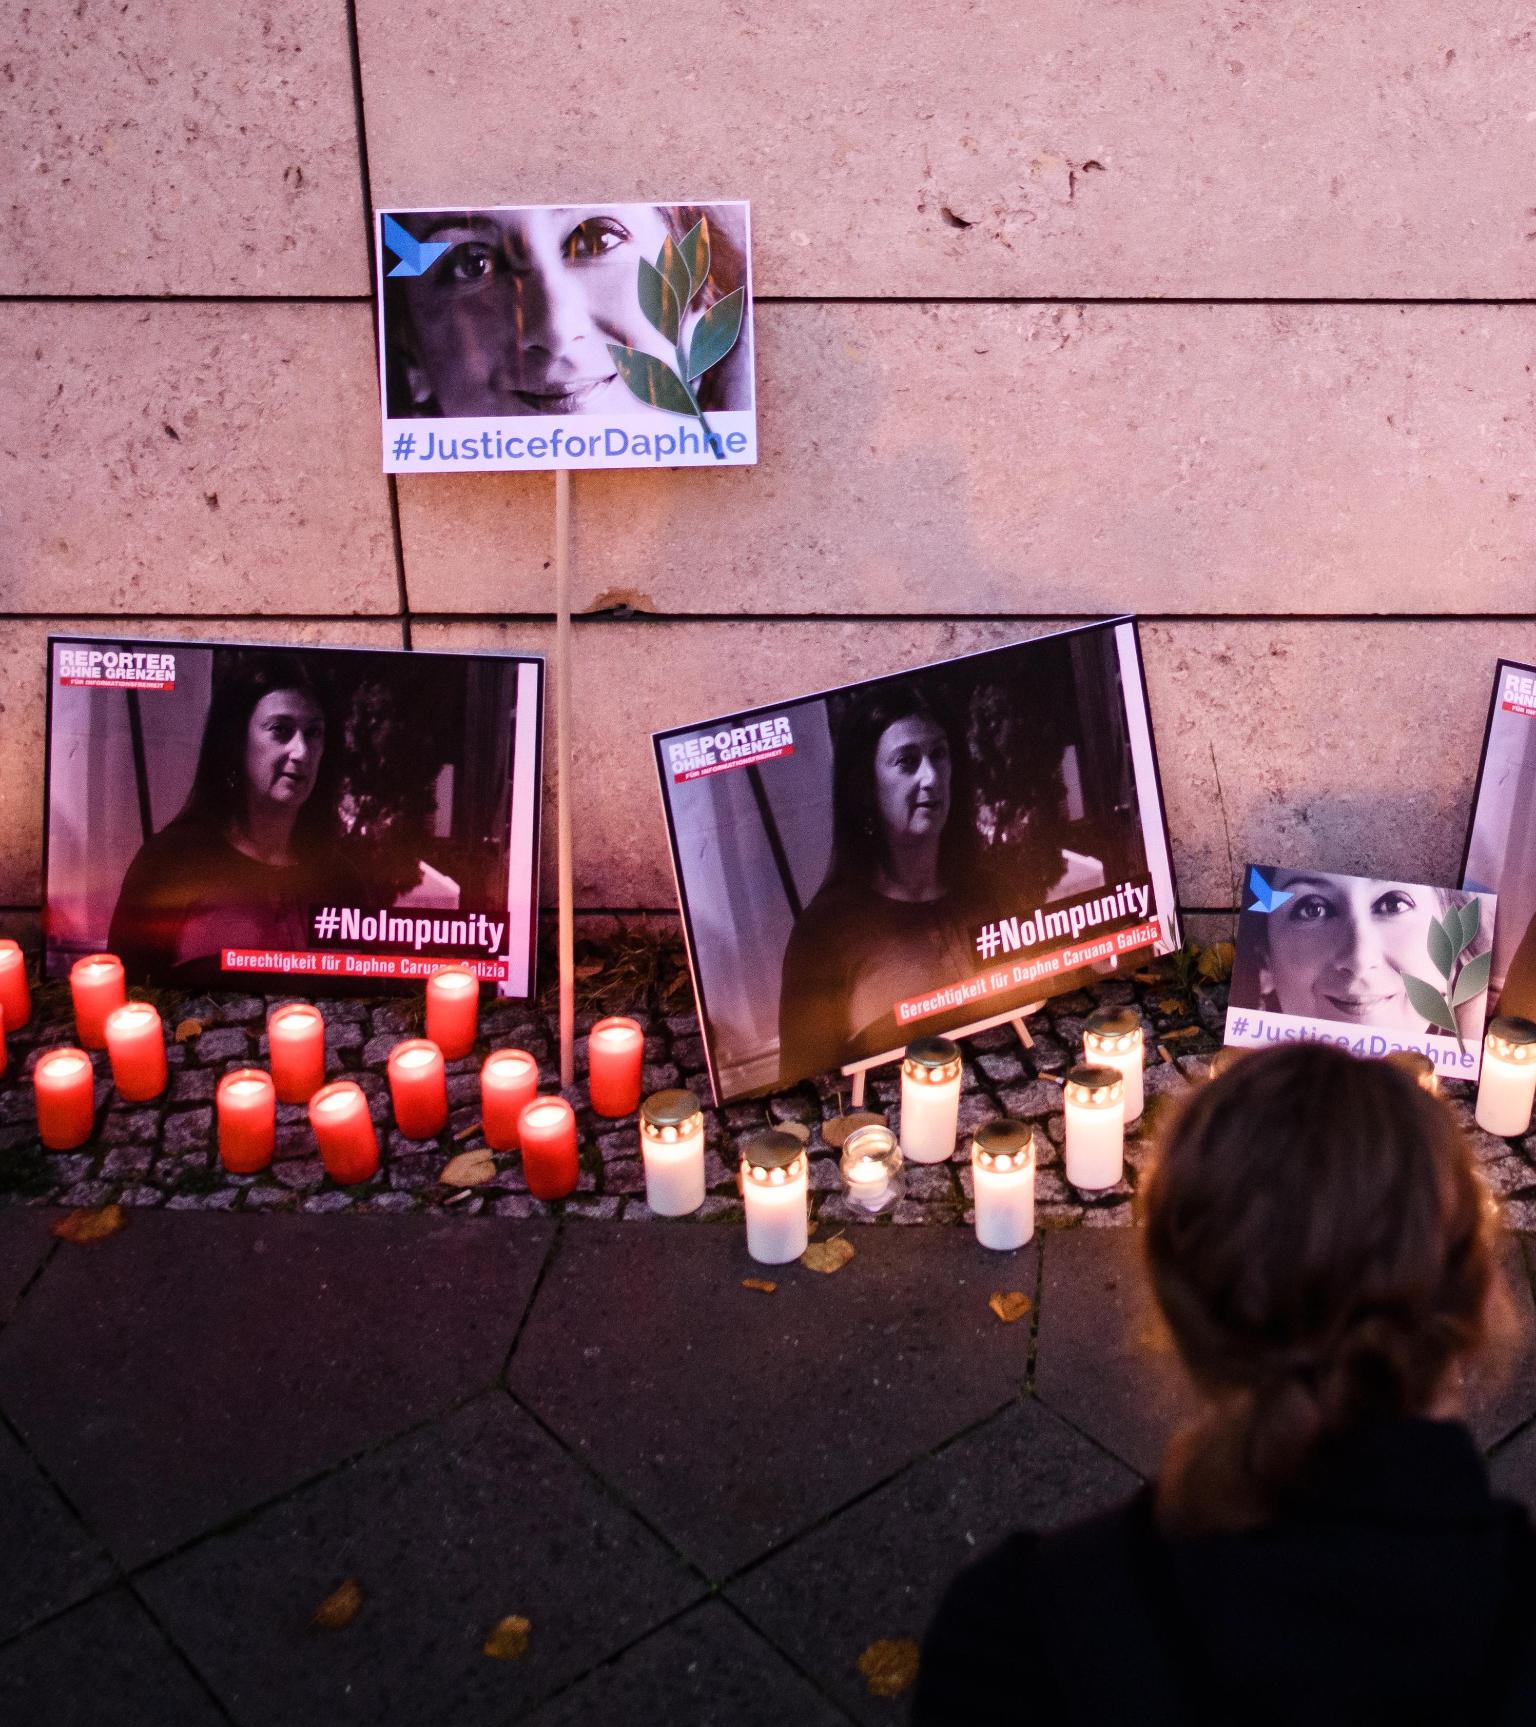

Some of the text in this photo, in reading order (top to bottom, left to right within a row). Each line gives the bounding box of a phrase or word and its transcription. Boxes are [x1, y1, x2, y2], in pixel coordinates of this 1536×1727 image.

[392, 426, 748, 461] #JusticeforDaphne
[60, 650, 176, 670] REPORTER
[60, 666, 176, 682] OHNE GRENZEN
[668, 716, 791, 762] REPORTER
[671, 732, 794, 773] OHNE GRENZEN
[314, 906, 504, 953] #NoImpunity
[976, 881, 1149, 960] #NoImpunity
[226, 951, 505, 978] Gerechtigkeit für Daphne Carua alizia
[900, 925, 1158, 1020] Gerechtigkeit für Daphne Caruana Galizia
